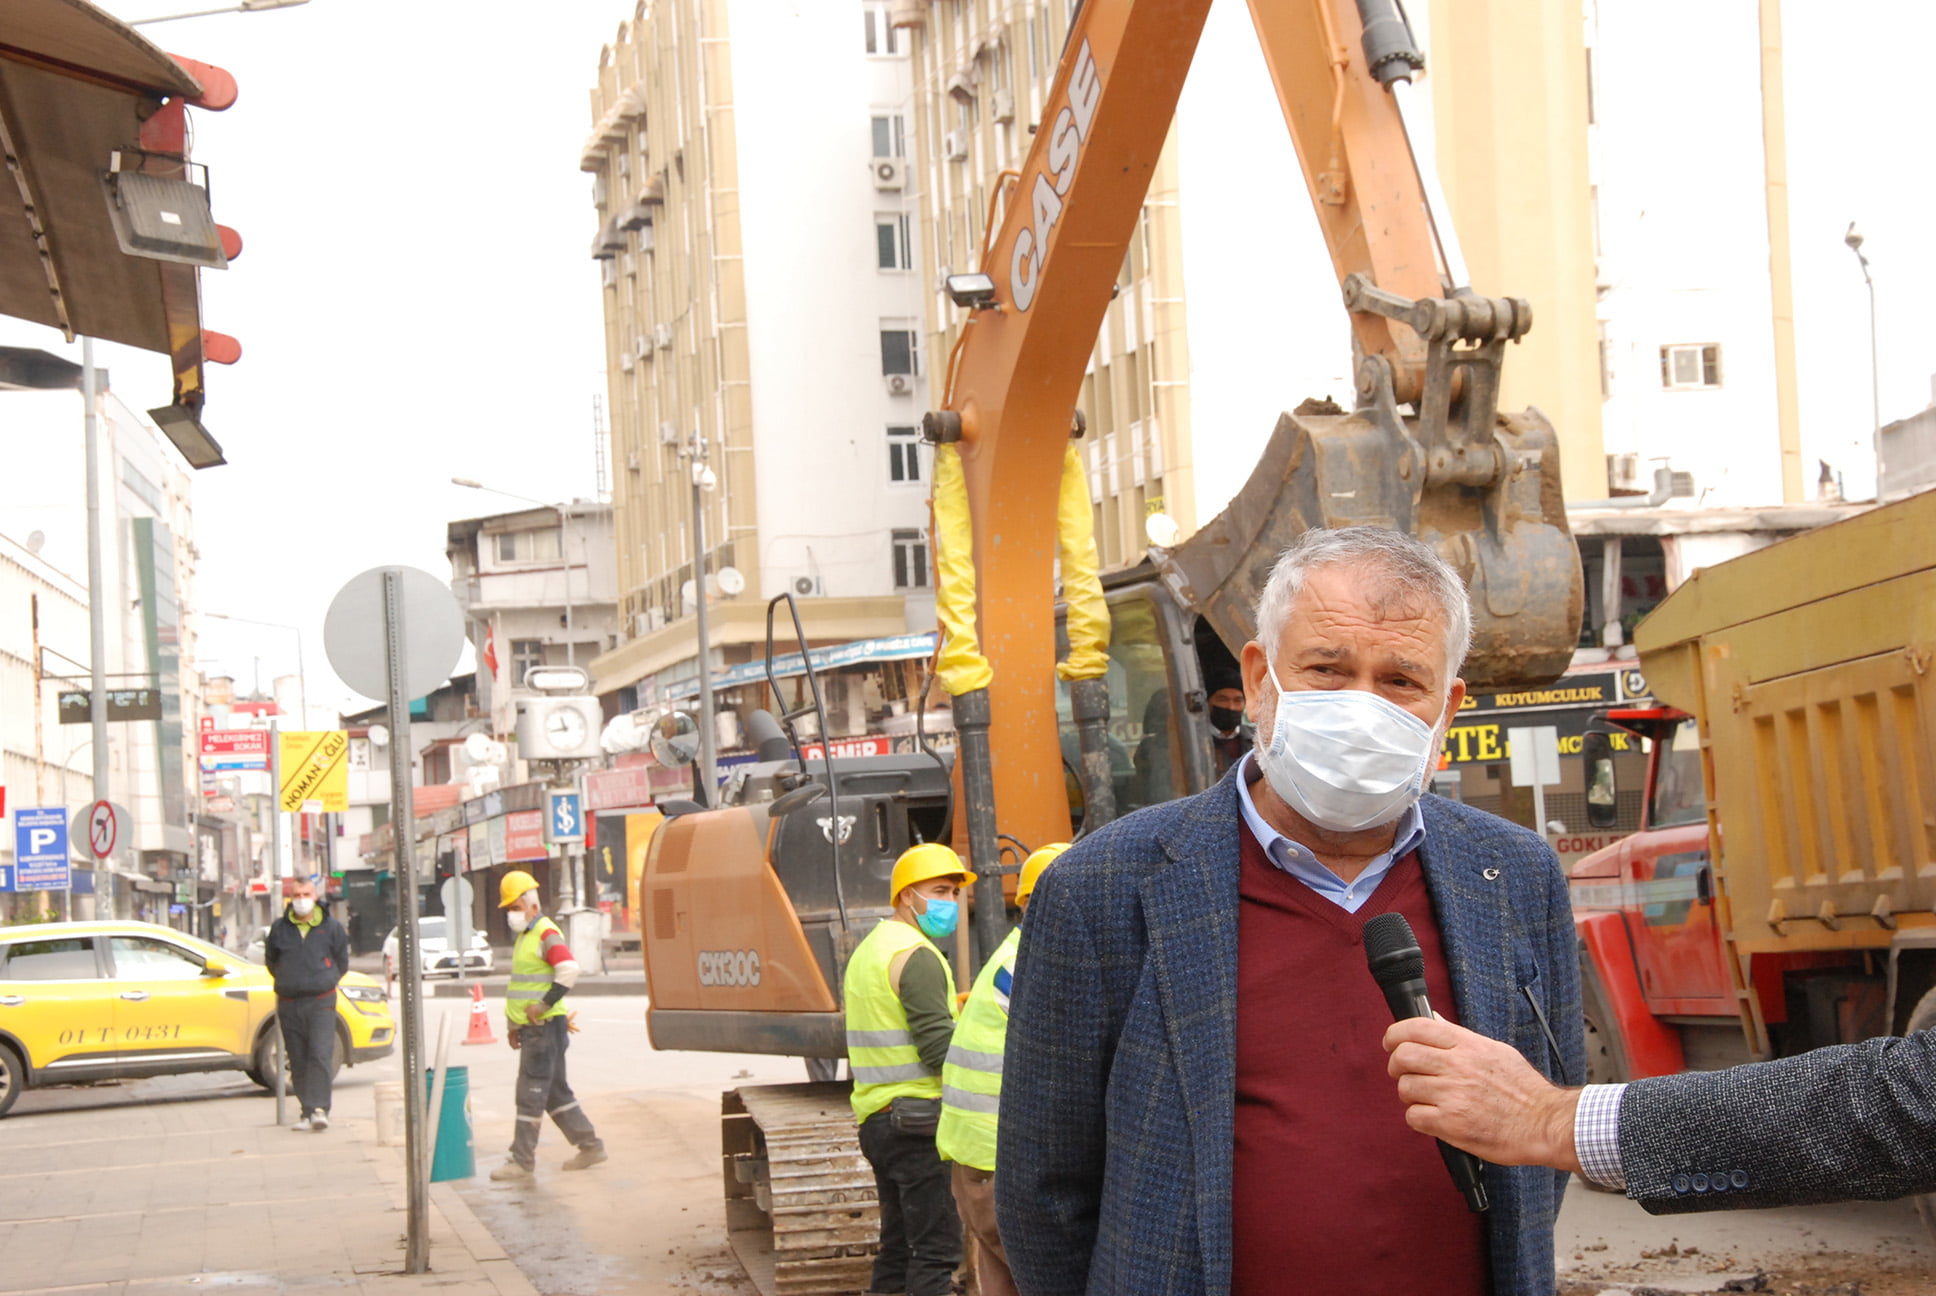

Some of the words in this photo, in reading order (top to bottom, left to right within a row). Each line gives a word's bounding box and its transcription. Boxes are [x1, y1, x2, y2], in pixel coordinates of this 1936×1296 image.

[1010, 34, 1101, 313] CASE
[1495, 686, 1604, 706] KUYUMCULUK
[30, 828, 57, 854] P
[697, 948, 761, 988] CX130C
[97, 1026, 115, 1042] T
